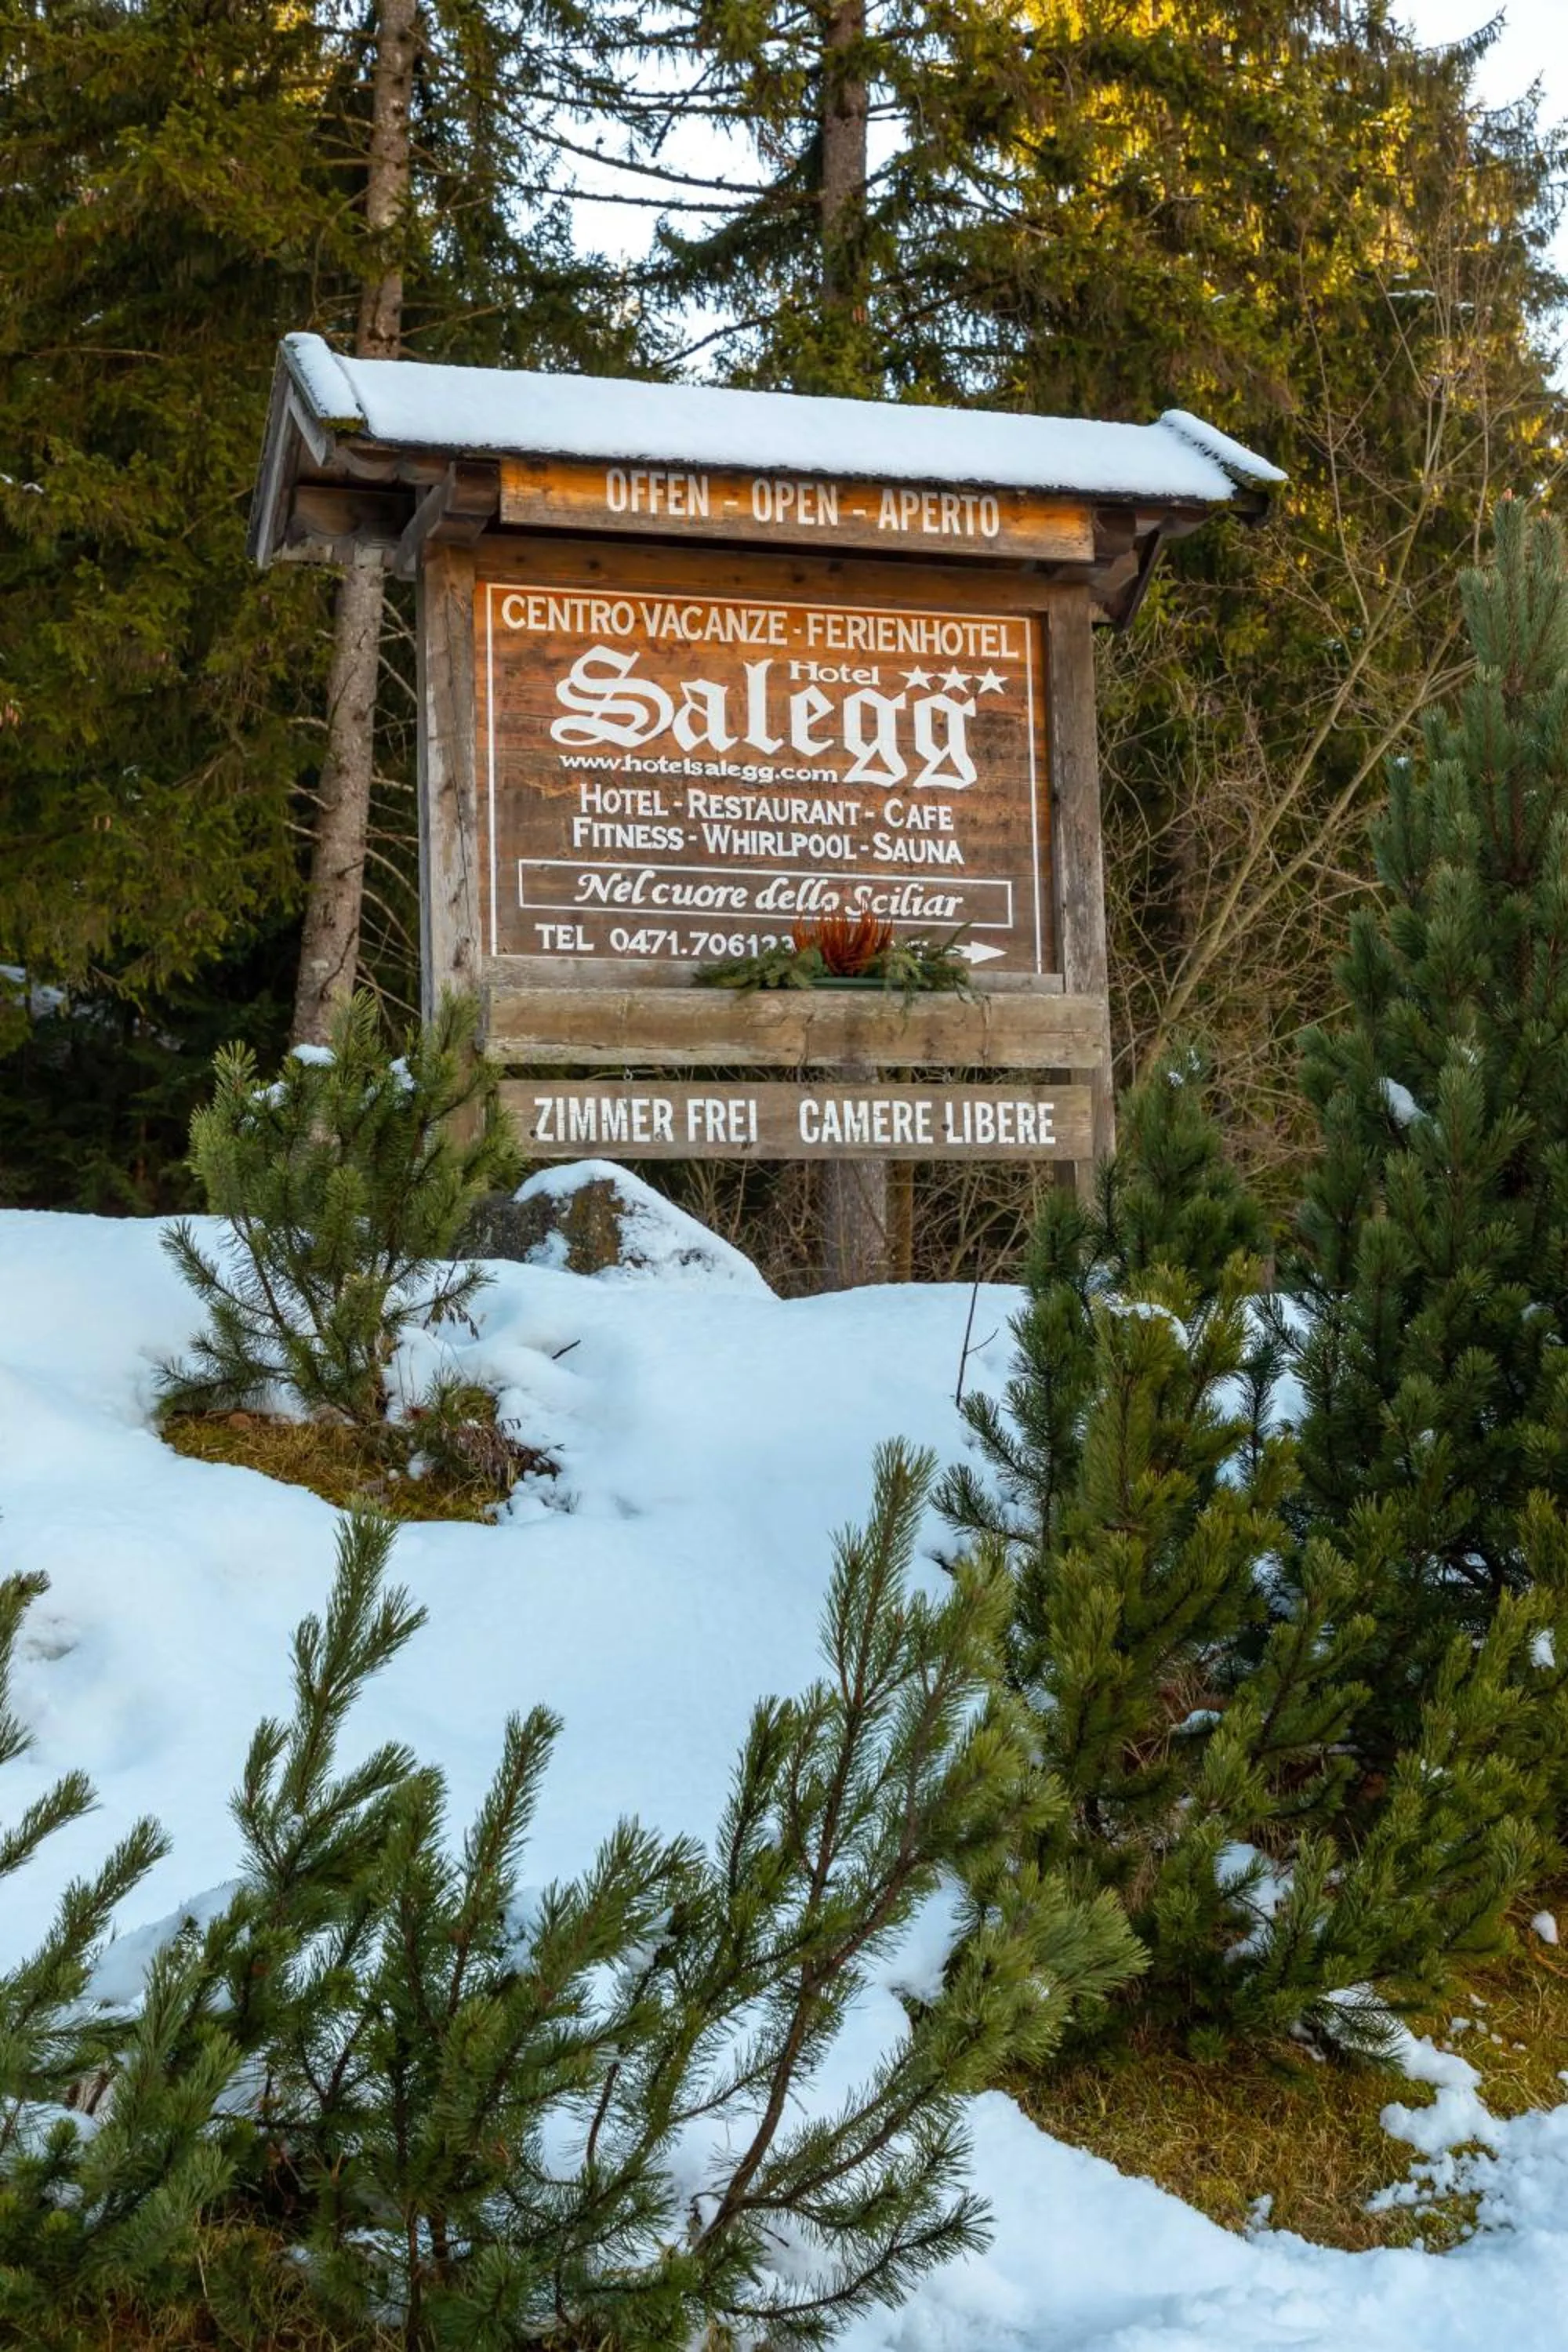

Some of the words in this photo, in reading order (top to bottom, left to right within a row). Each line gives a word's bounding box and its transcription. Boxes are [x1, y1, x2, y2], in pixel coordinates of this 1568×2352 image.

[606, 467, 710, 517] OFFEN
[751, 477, 839, 526] OPEN
[877, 488, 1000, 538] APERTO
[501, 593, 635, 637] CENTRO
[638, 601, 788, 646] VACANZE
[806, 612, 1019, 659] FERIENHOTEL
[788, 659, 881, 686] Hotel
[550, 644, 978, 791] Salegg
[558, 753, 838, 784] www.hotelsalegg.com
[580, 783, 669, 817] HOTEL
[687, 788, 861, 826] RESTAURANT
[884, 797, 955, 831] CAFE
[572, 816, 684, 851] FITNESS
[702, 822, 858, 860] WHIRLPOOL
[872, 832, 965, 865] SAUNA
[574, 869, 656, 905] Nel
[652, 883, 749, 909] cuore
[844, 884, 964, 917] Sciliar
[534, 923, 595, 951] TEL
[534, 1097, 674, 1142] ZIMMER
[687, 1098, 757, 1142] FREI
[799, 1098, 934, 1144] CAMERE
[945, 1102, 1056, 1145] LIBERE
